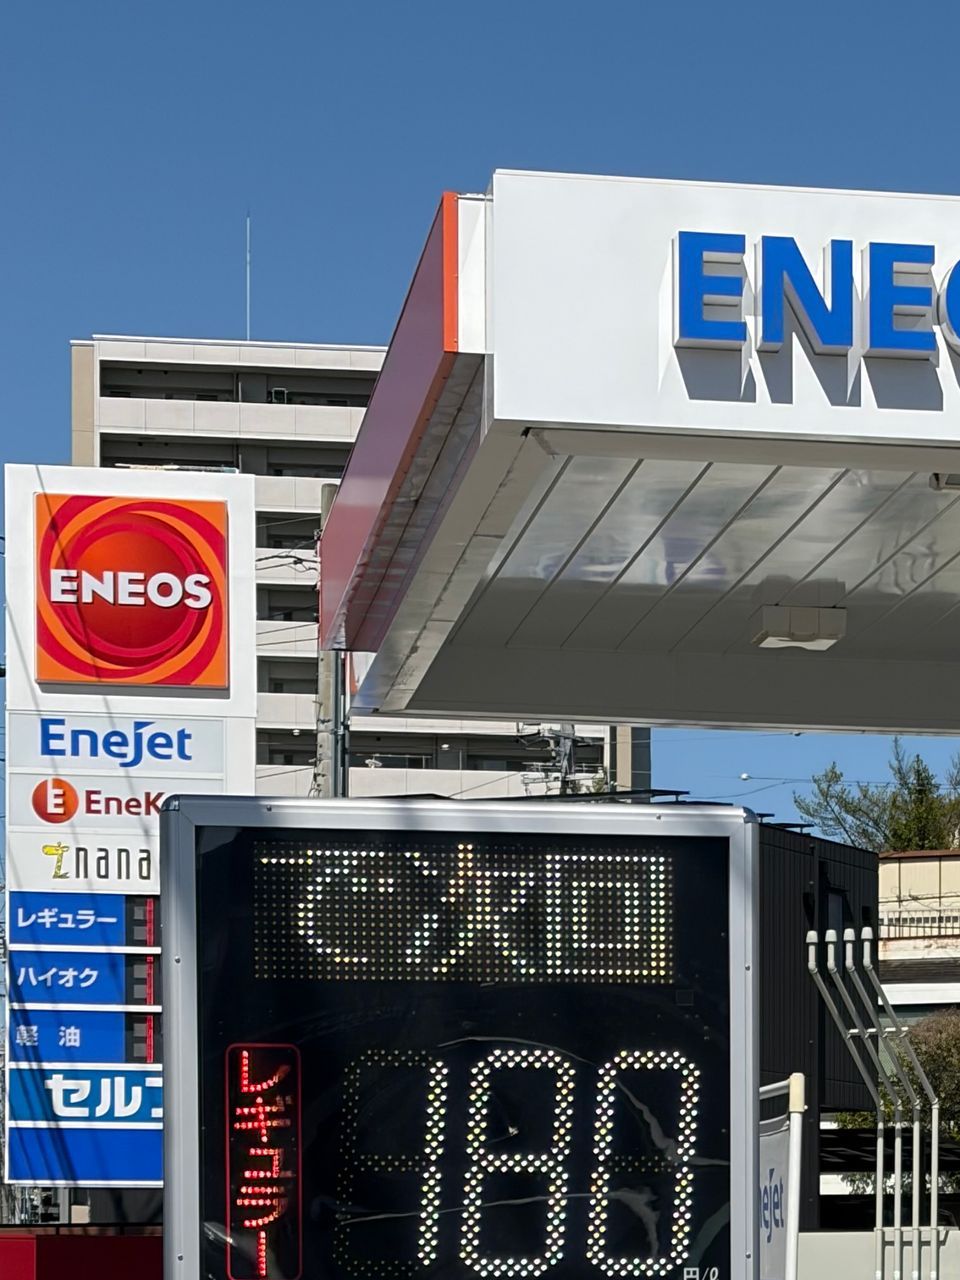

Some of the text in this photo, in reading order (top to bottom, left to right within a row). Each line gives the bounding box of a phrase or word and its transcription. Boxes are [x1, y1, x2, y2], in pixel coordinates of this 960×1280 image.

[50, 569, 213, 609] ENEOS
[17, 908, 118, 929] レギュラー
[17, 966, 99, 988] ハイオク
[234, 1050, 294, 1277] レギュラー
[417, 1049, 701, 1278] 180
